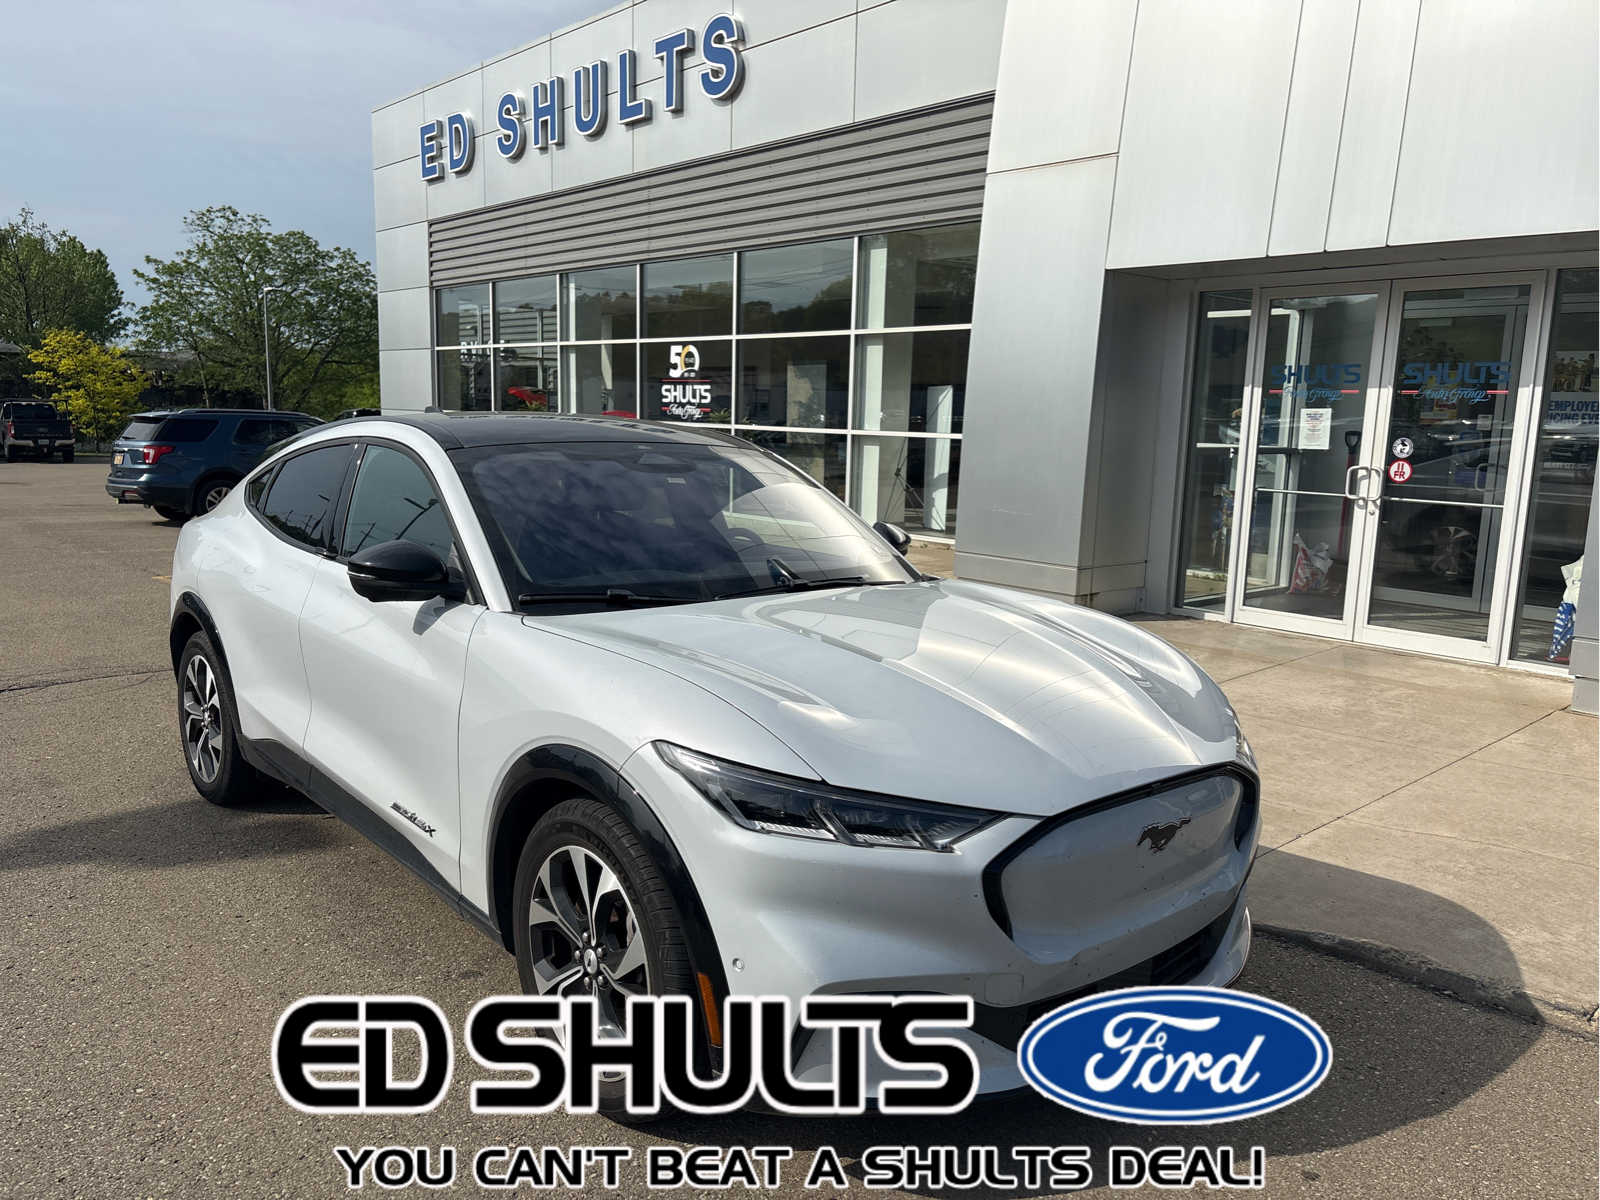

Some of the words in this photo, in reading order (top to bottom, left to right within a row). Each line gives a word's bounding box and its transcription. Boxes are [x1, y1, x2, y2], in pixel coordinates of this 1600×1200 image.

[420, 111, 474, 182] ED
[496, 13, 746, 159] SHULTS
[669, 344, 700, 378] 50
[1271, 363, 1361, 385] SHULTS
[1403, 361, 1513, 385] SHULTS
[661, 384, 711, 403] SHULTS
[1548, 400, 1599, 412] EMPLOYE
